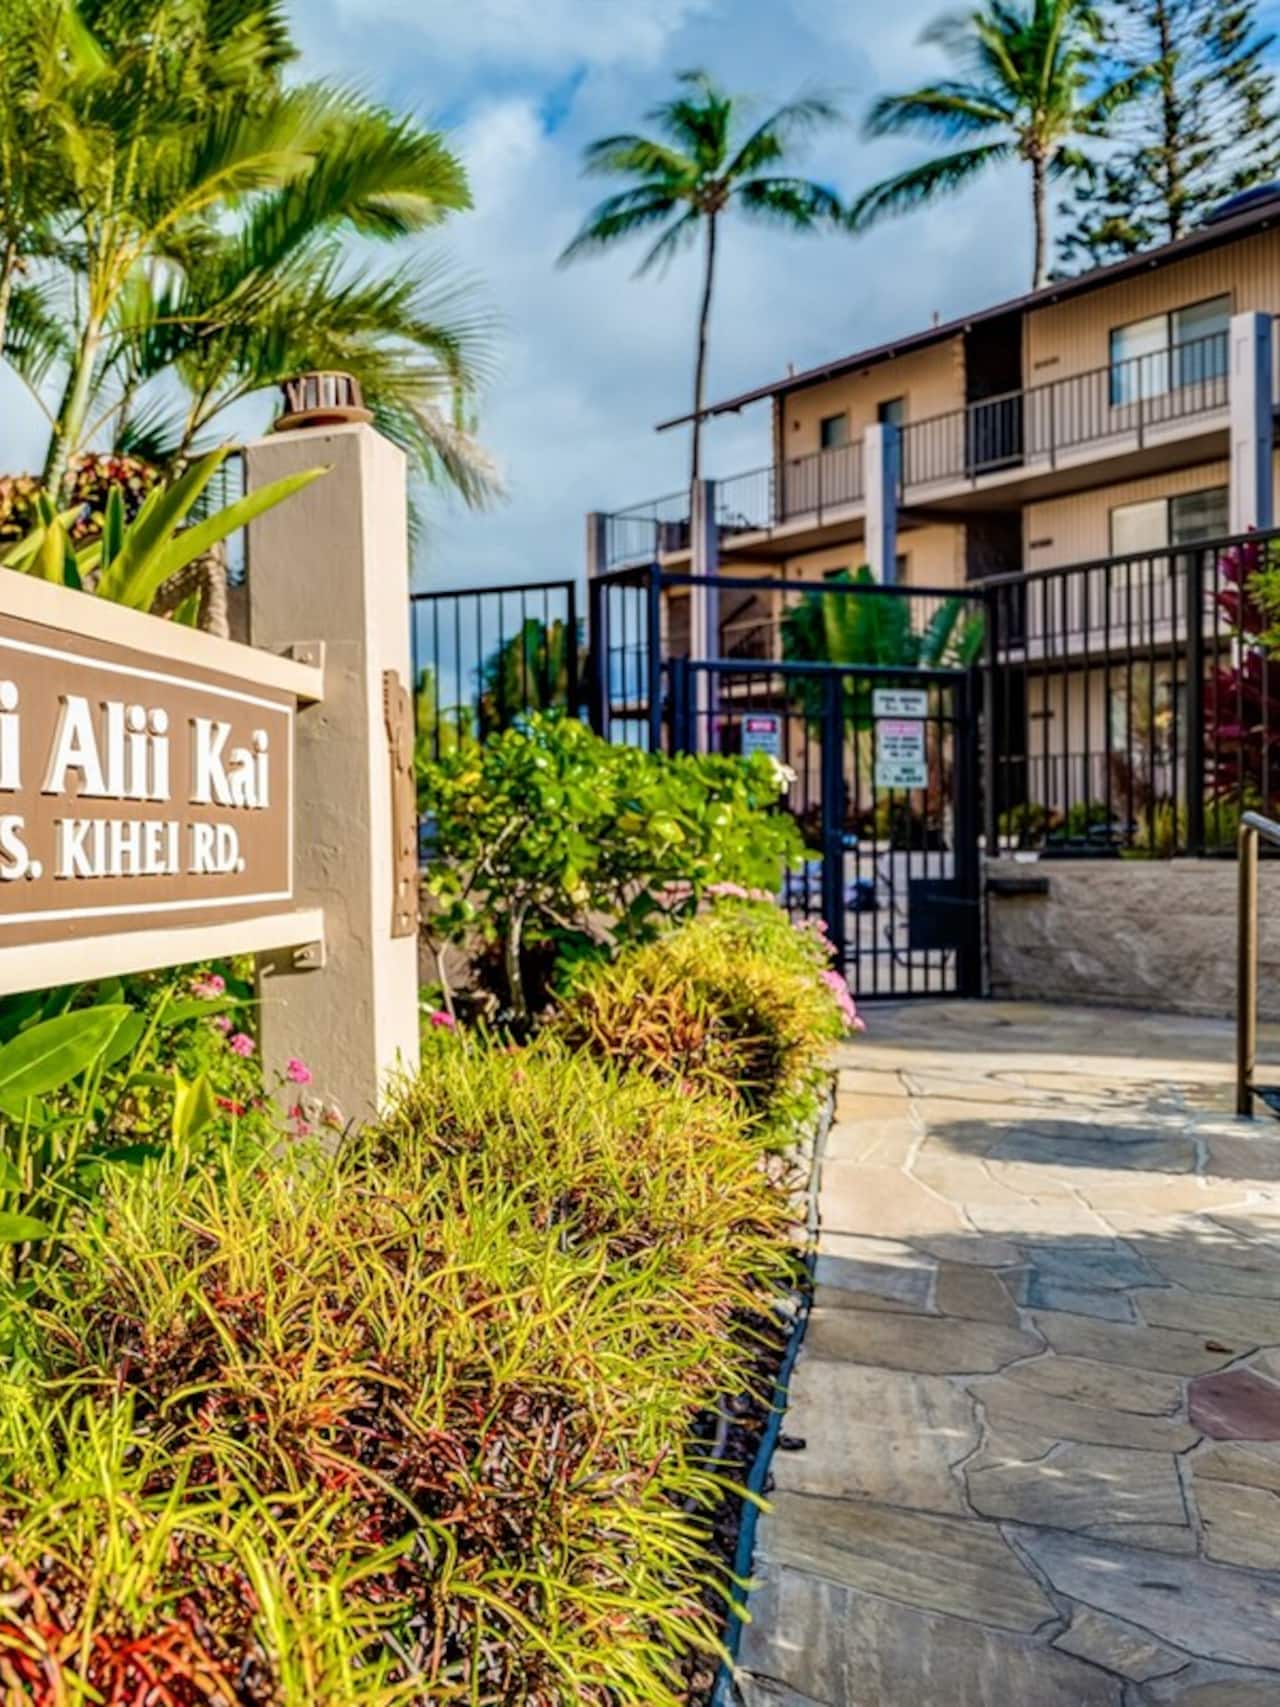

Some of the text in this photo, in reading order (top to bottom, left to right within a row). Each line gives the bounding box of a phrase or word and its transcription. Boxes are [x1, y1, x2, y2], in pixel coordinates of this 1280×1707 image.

[42, 695, 170, 802] Alii
[189, 717, 270, 809] Kai
[54, 817, 179, 880] KIHEI
[187, 822, 246, 876] RD.
